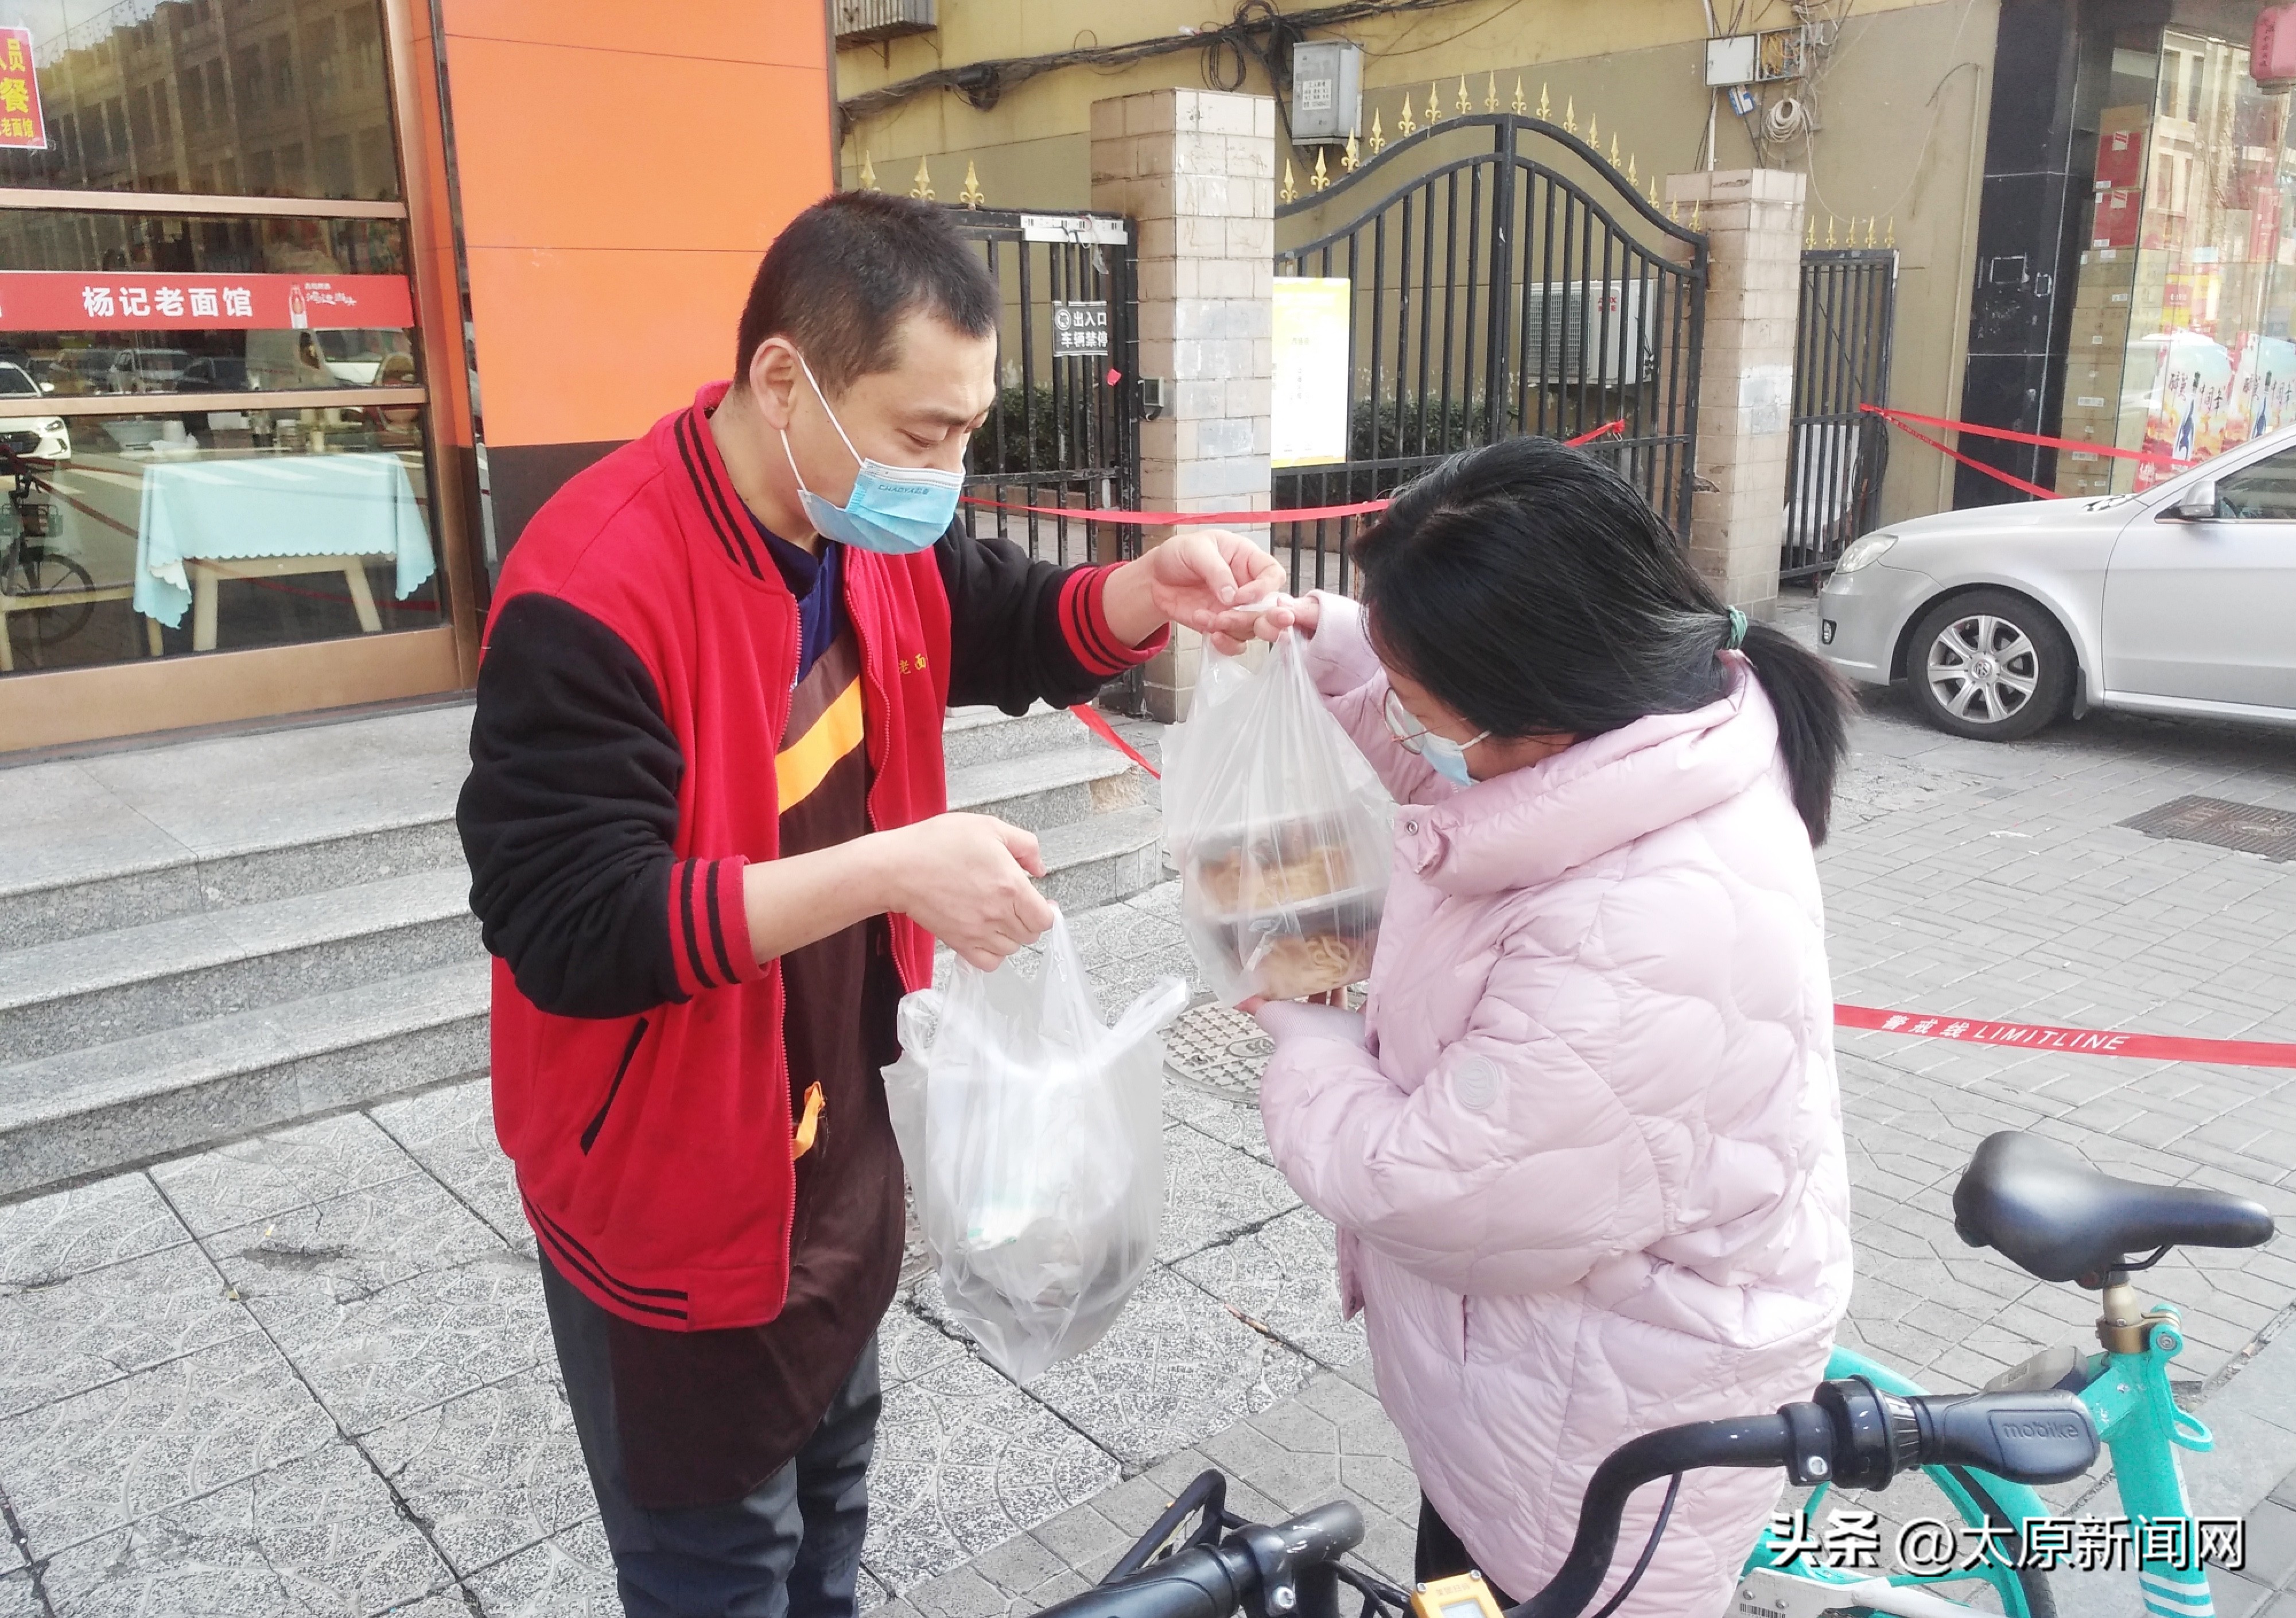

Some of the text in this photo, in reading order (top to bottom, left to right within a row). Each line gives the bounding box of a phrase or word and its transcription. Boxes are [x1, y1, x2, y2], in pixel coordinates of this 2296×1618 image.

[0, 77, 29, 113] 餐
[0, 118, 34, 138] 老面馆
[82, 286, 253, 317] 杨记老面馆
[1073, 311, 1107, 327] 出入口
[1060, 331, 1109, 348] 车辆禁停
[1881, 1014, 2130, 1050] 警戒线 LIMITLINE
[2003, 1421, 2079, 1439] mobike
